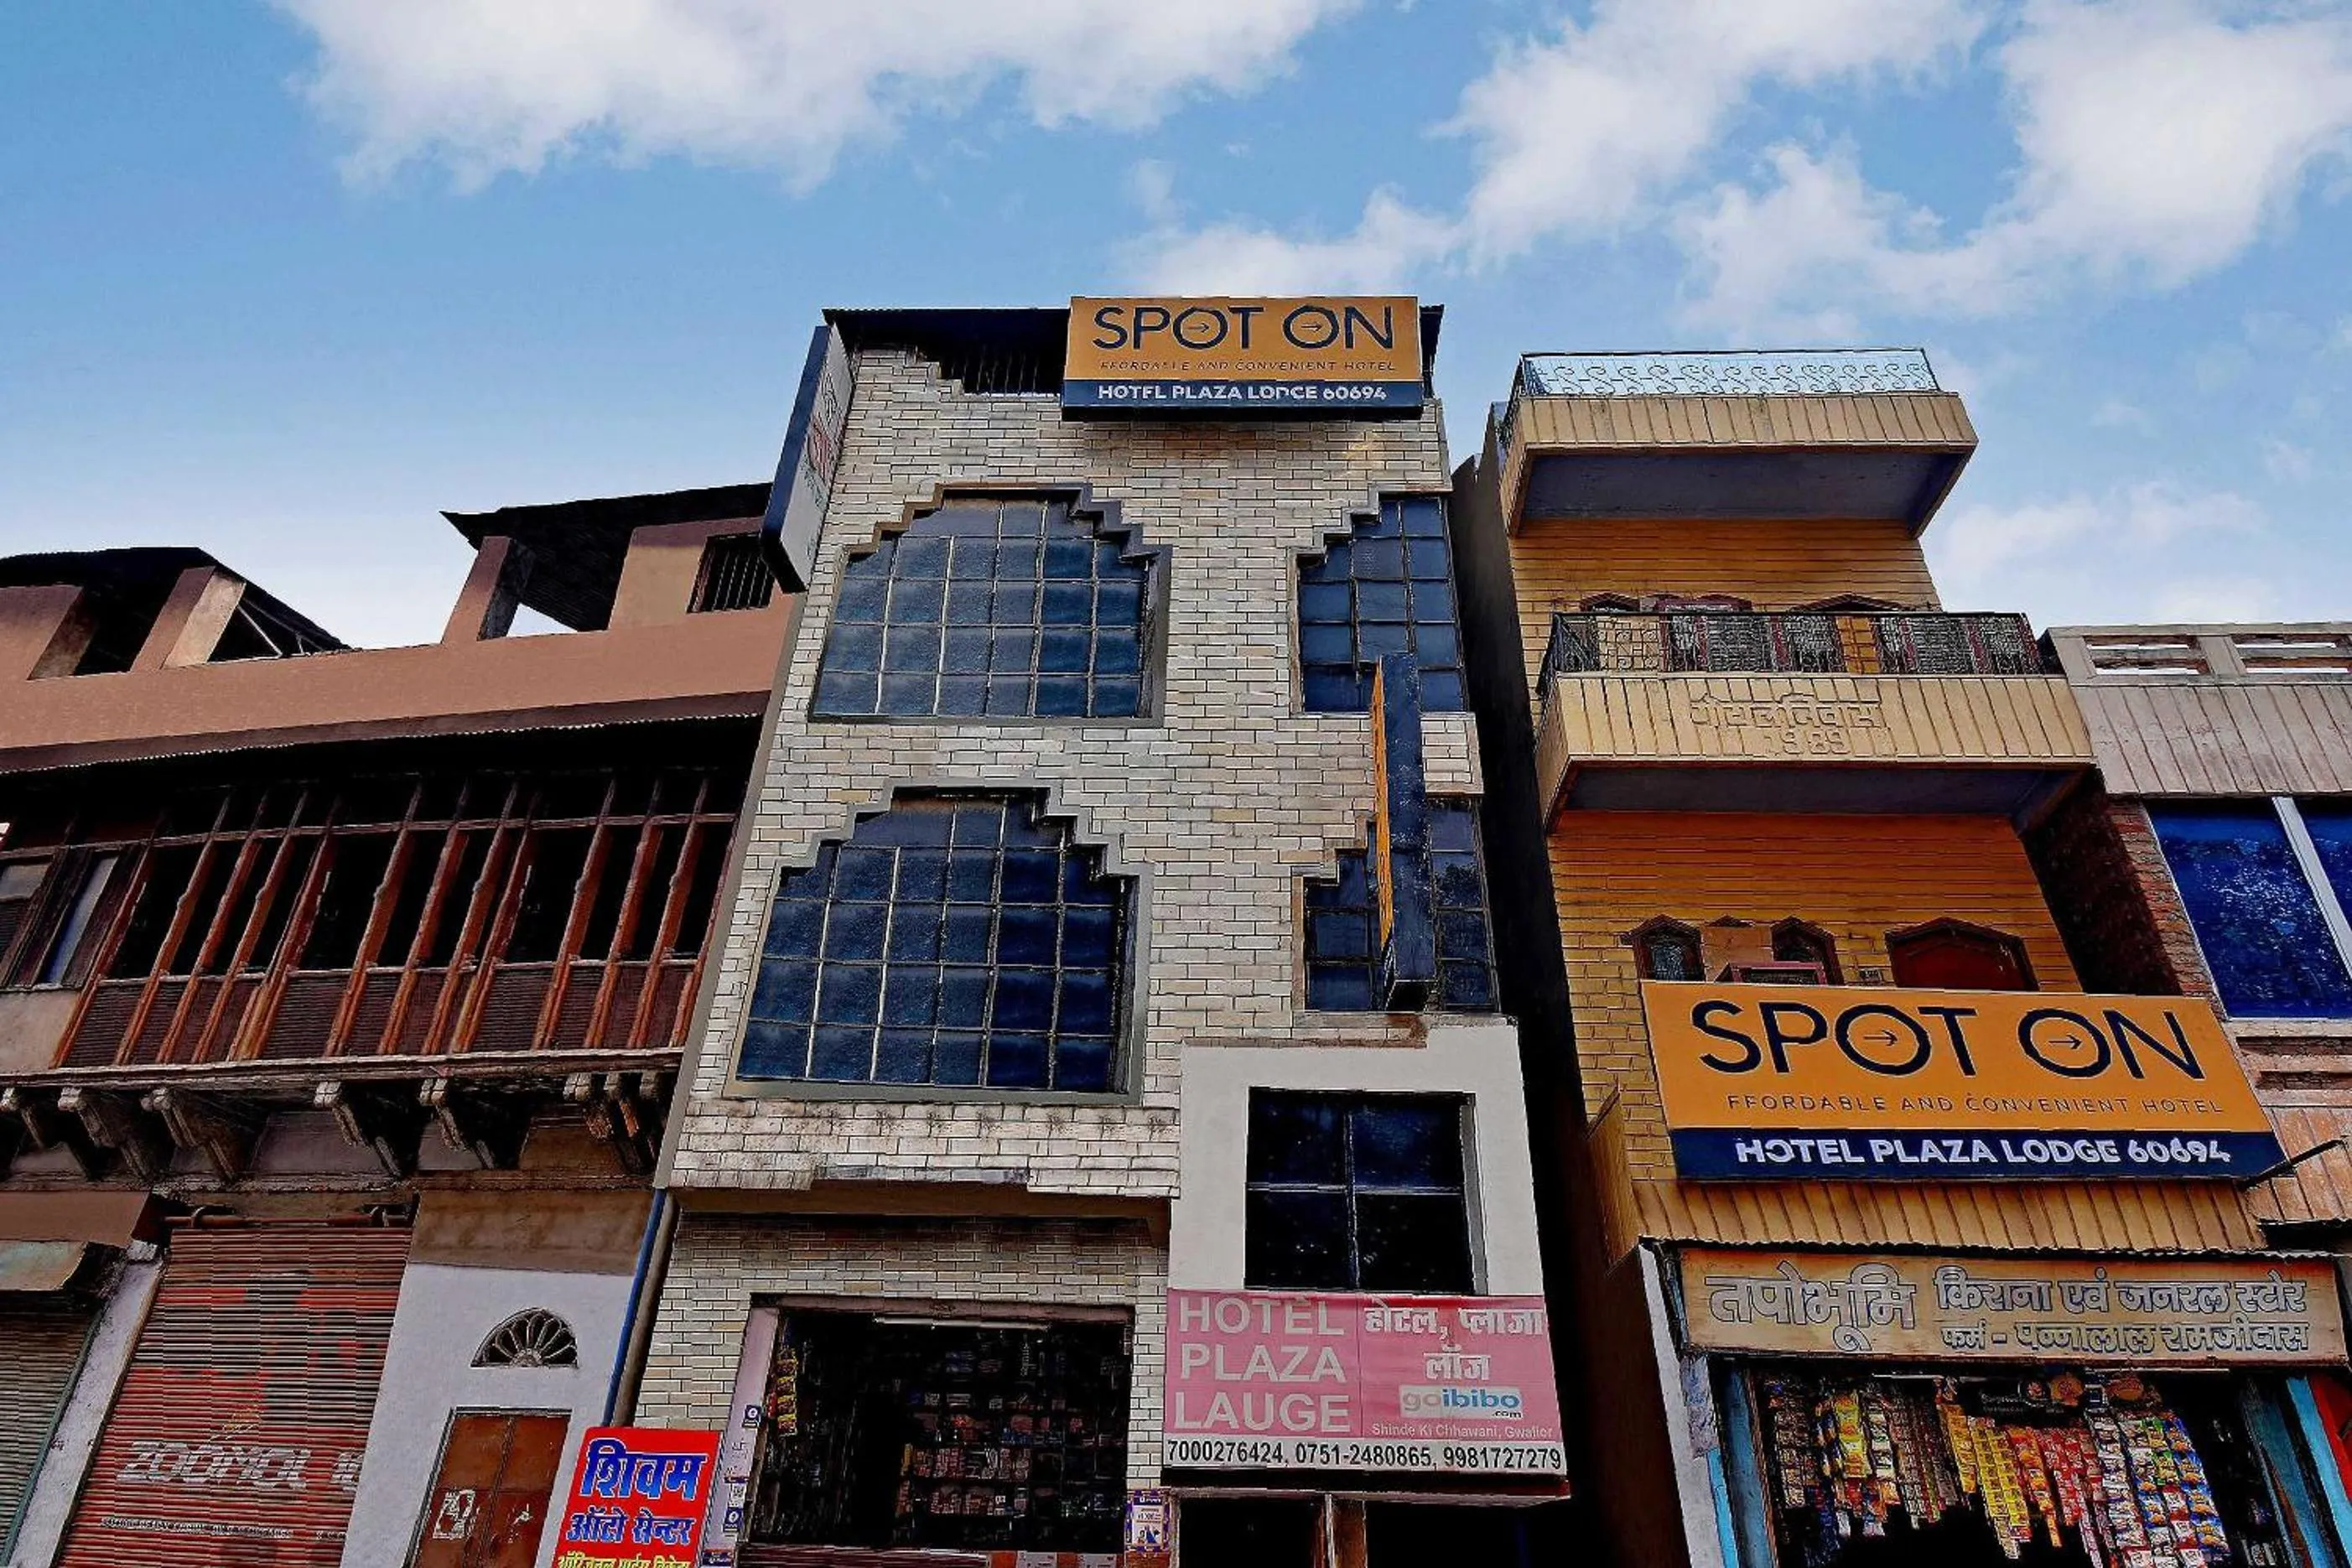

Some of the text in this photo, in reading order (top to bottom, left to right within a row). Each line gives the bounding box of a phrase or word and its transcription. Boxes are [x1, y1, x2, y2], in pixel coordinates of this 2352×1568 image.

[1092, 304, 1394, 350] SPOT ON
[1197, 361, 1228, 371] AND
[1235, 360, 1337, 371] CONVENIENT
[1344, 361, 1396, 371] HOTEL
[1098, 385, 1166, 399] HOTEL
[1172, 385, 1242, 399] PLAZA
[1322, 386, 1387, 401] 60694
[1690, 999, 2206, 1081] SPOT ON
[1901, 1095, 1954, 1112] AND
[1965, 1094, 2129, 1114] CONVENIENT
[2143, 1098, 2224, 1114] HOTEL
[1735, 1135, 2230, 1164] HOTEL PLAZA LODGE 60694
[1705, 1260, 1917, 1351] तपोभूमि
[1934, 1264, 2308, 1314] किराना एवं जनरल स्टोर
[1179, 1296, 1345, 1335] HOTEL
[1180, 1342, 1347, 1383] PLAZA
[1424, 1343, 1491, 1380] लॉज
[1175, 1391, 1351, 1432] LAUGE
[1402, 1389, 1520, 1412] goibibo
[1492, 1410, 1523, 1419] .com
[1371, 1423, 1415, 1436] Shinde
[1419, 1423, 1433, 1436] Ki
[1505, 1425, 1553, 1438] Gwalior
[579, 1437, 709, 1501] शिवम
[1167, 1440, 1562, 1470] 7000276424, 0751-2480865, 9981727279
